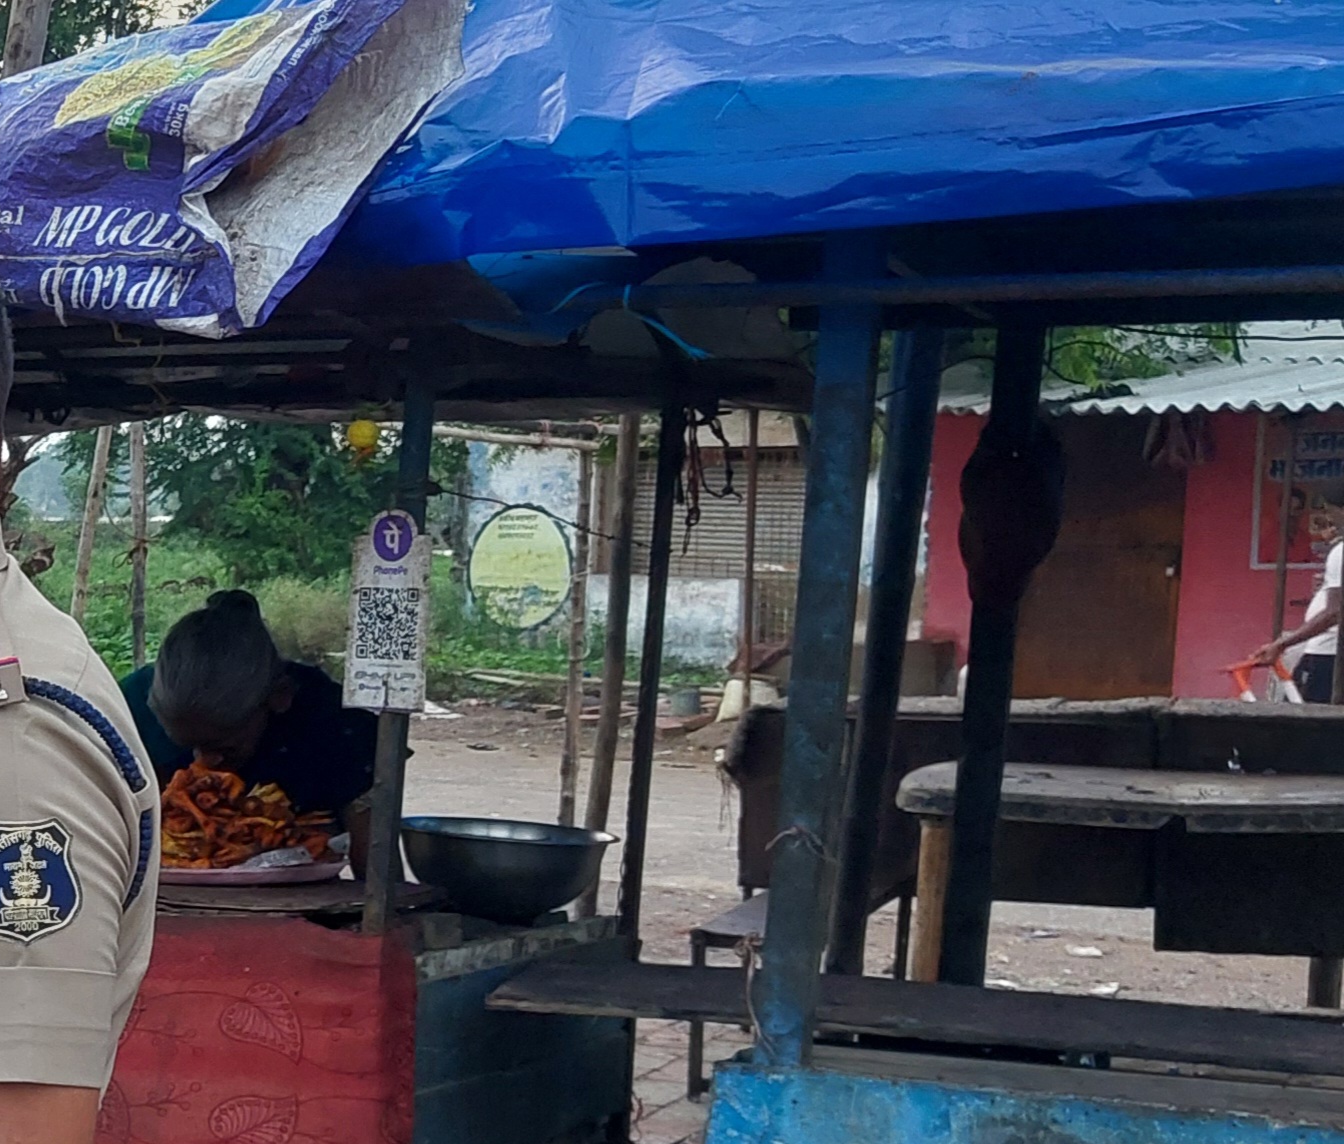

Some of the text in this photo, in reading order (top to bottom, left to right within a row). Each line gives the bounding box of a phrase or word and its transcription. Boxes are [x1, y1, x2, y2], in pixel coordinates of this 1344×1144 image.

[168, 102, 190, 137] 30kg
[32, 205, 103, 248] MP
[39, 263, 127, 310] GOLD
[126, 265, 196, 310] MP
